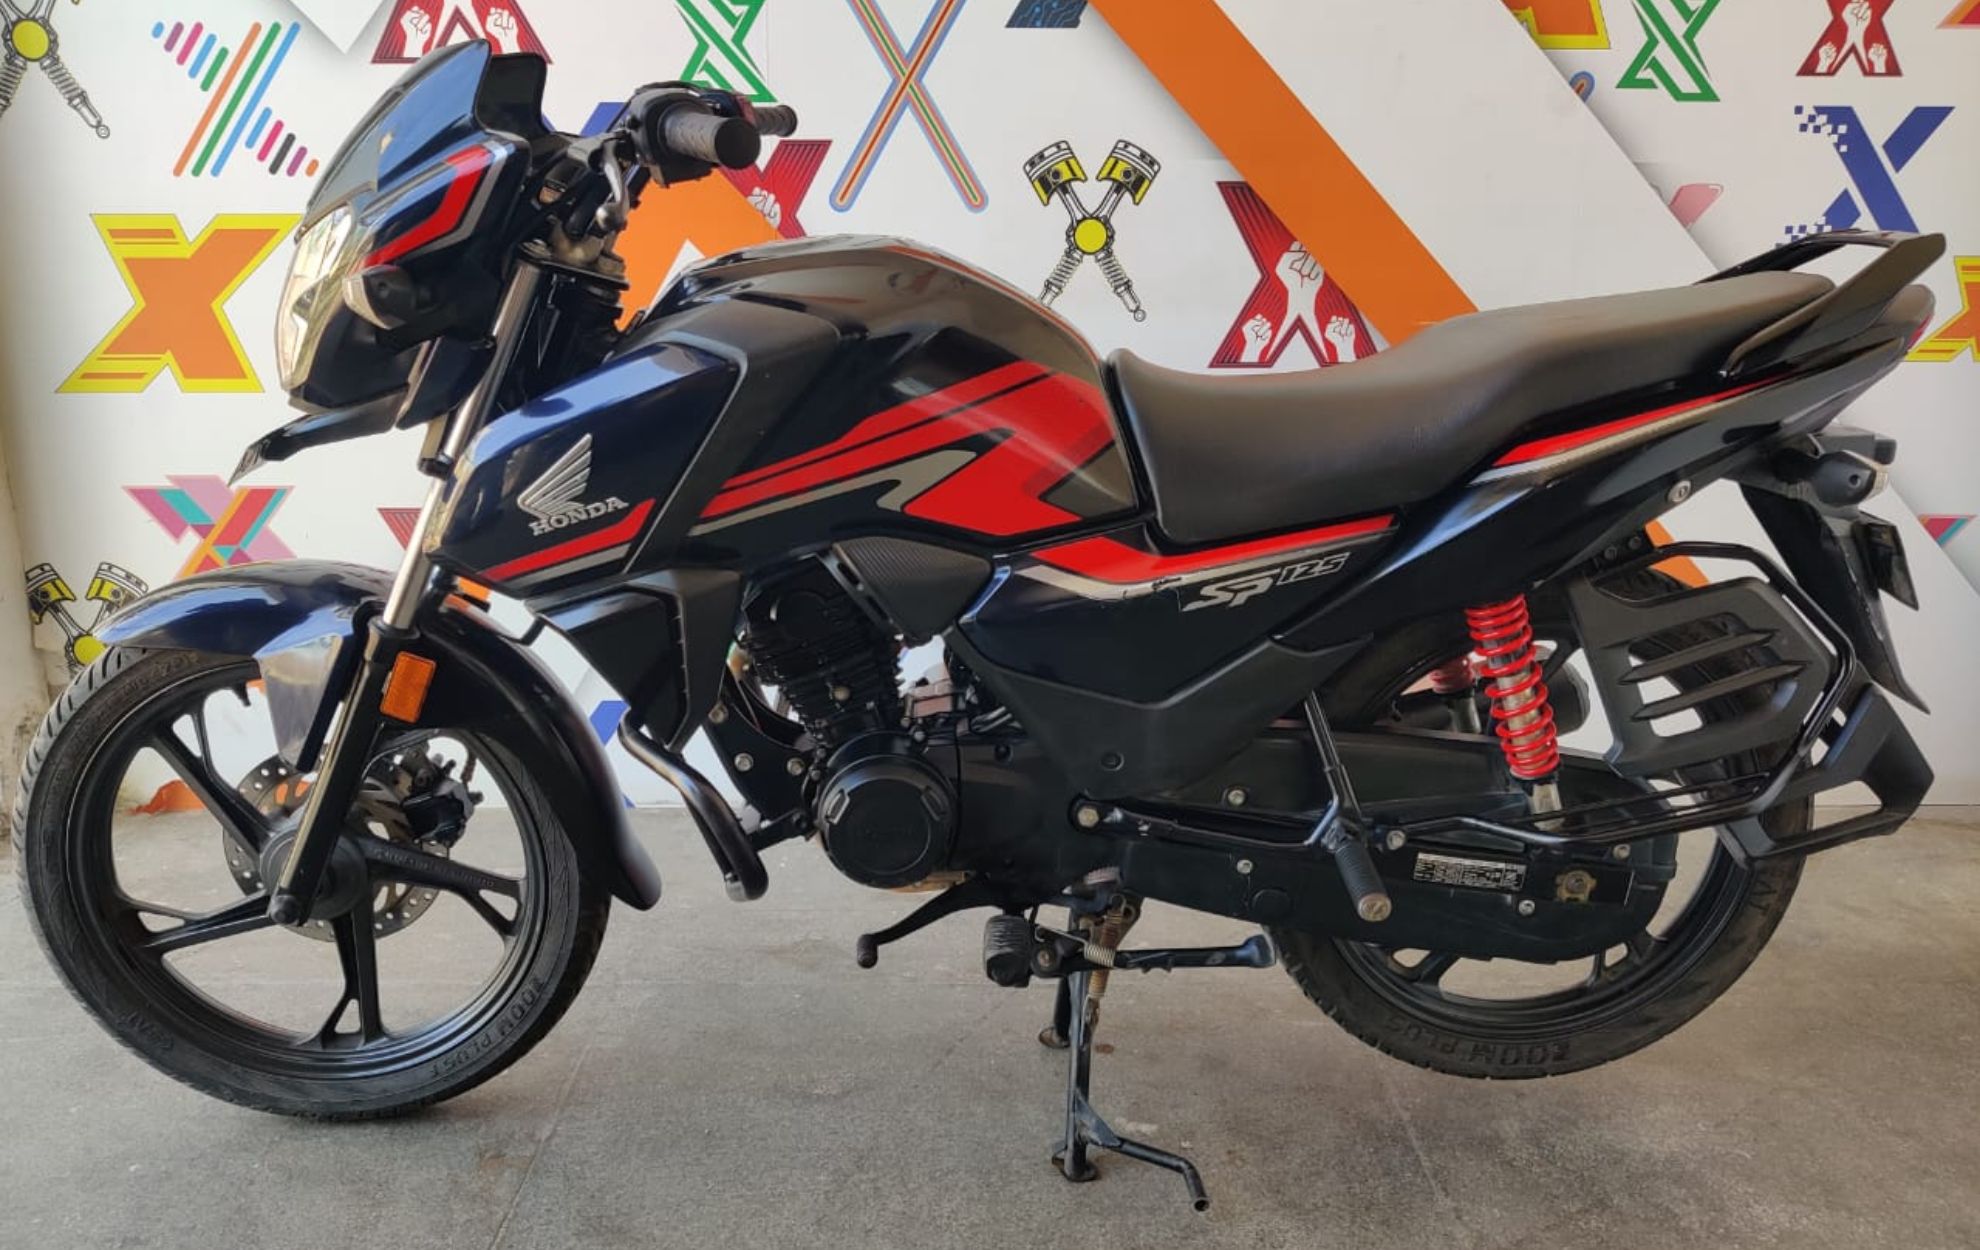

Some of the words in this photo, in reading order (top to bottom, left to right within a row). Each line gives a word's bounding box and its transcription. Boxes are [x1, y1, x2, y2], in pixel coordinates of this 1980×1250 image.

[528, 497, 630, 537] HONDA
[1182, 568, 1281, 612] SP
[1276, 552, 1352, 586] 125
